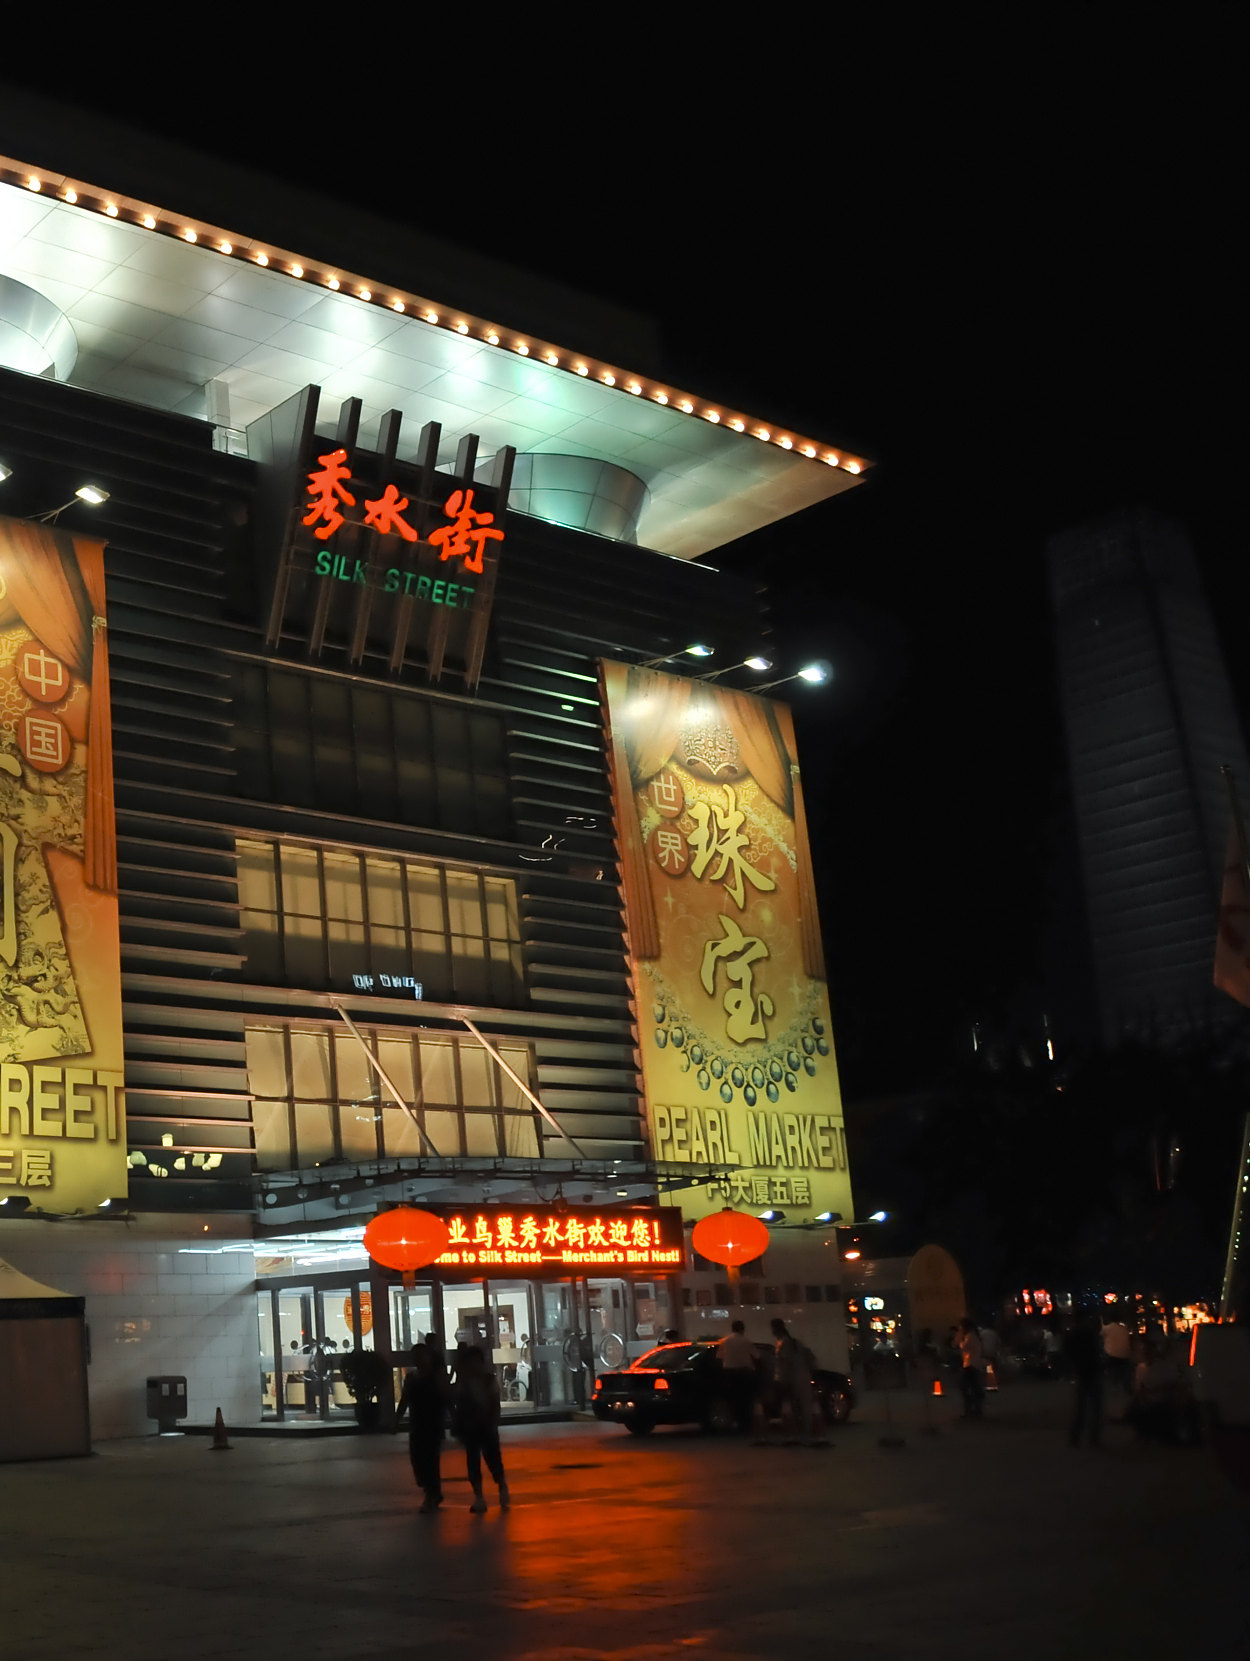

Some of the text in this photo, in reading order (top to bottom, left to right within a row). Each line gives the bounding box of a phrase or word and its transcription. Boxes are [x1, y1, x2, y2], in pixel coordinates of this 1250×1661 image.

[302, 448, 505, 574] 秀水街
[315, 550, 475, 609] SILK STREET
[23, 649, 63, 765] 中国
[650, 772, 685, 869] 世界
[686, 783, 776, 1044] 珠宝
[652, 1104, 846, 1169] PEARL MARKET
[462, 1250, 476, 1263] to
[478, 1250, 503, 1263] Silk
[626, 1249, 649, 1263] Bird
[651, 1249, 679, 1263] Nest!
